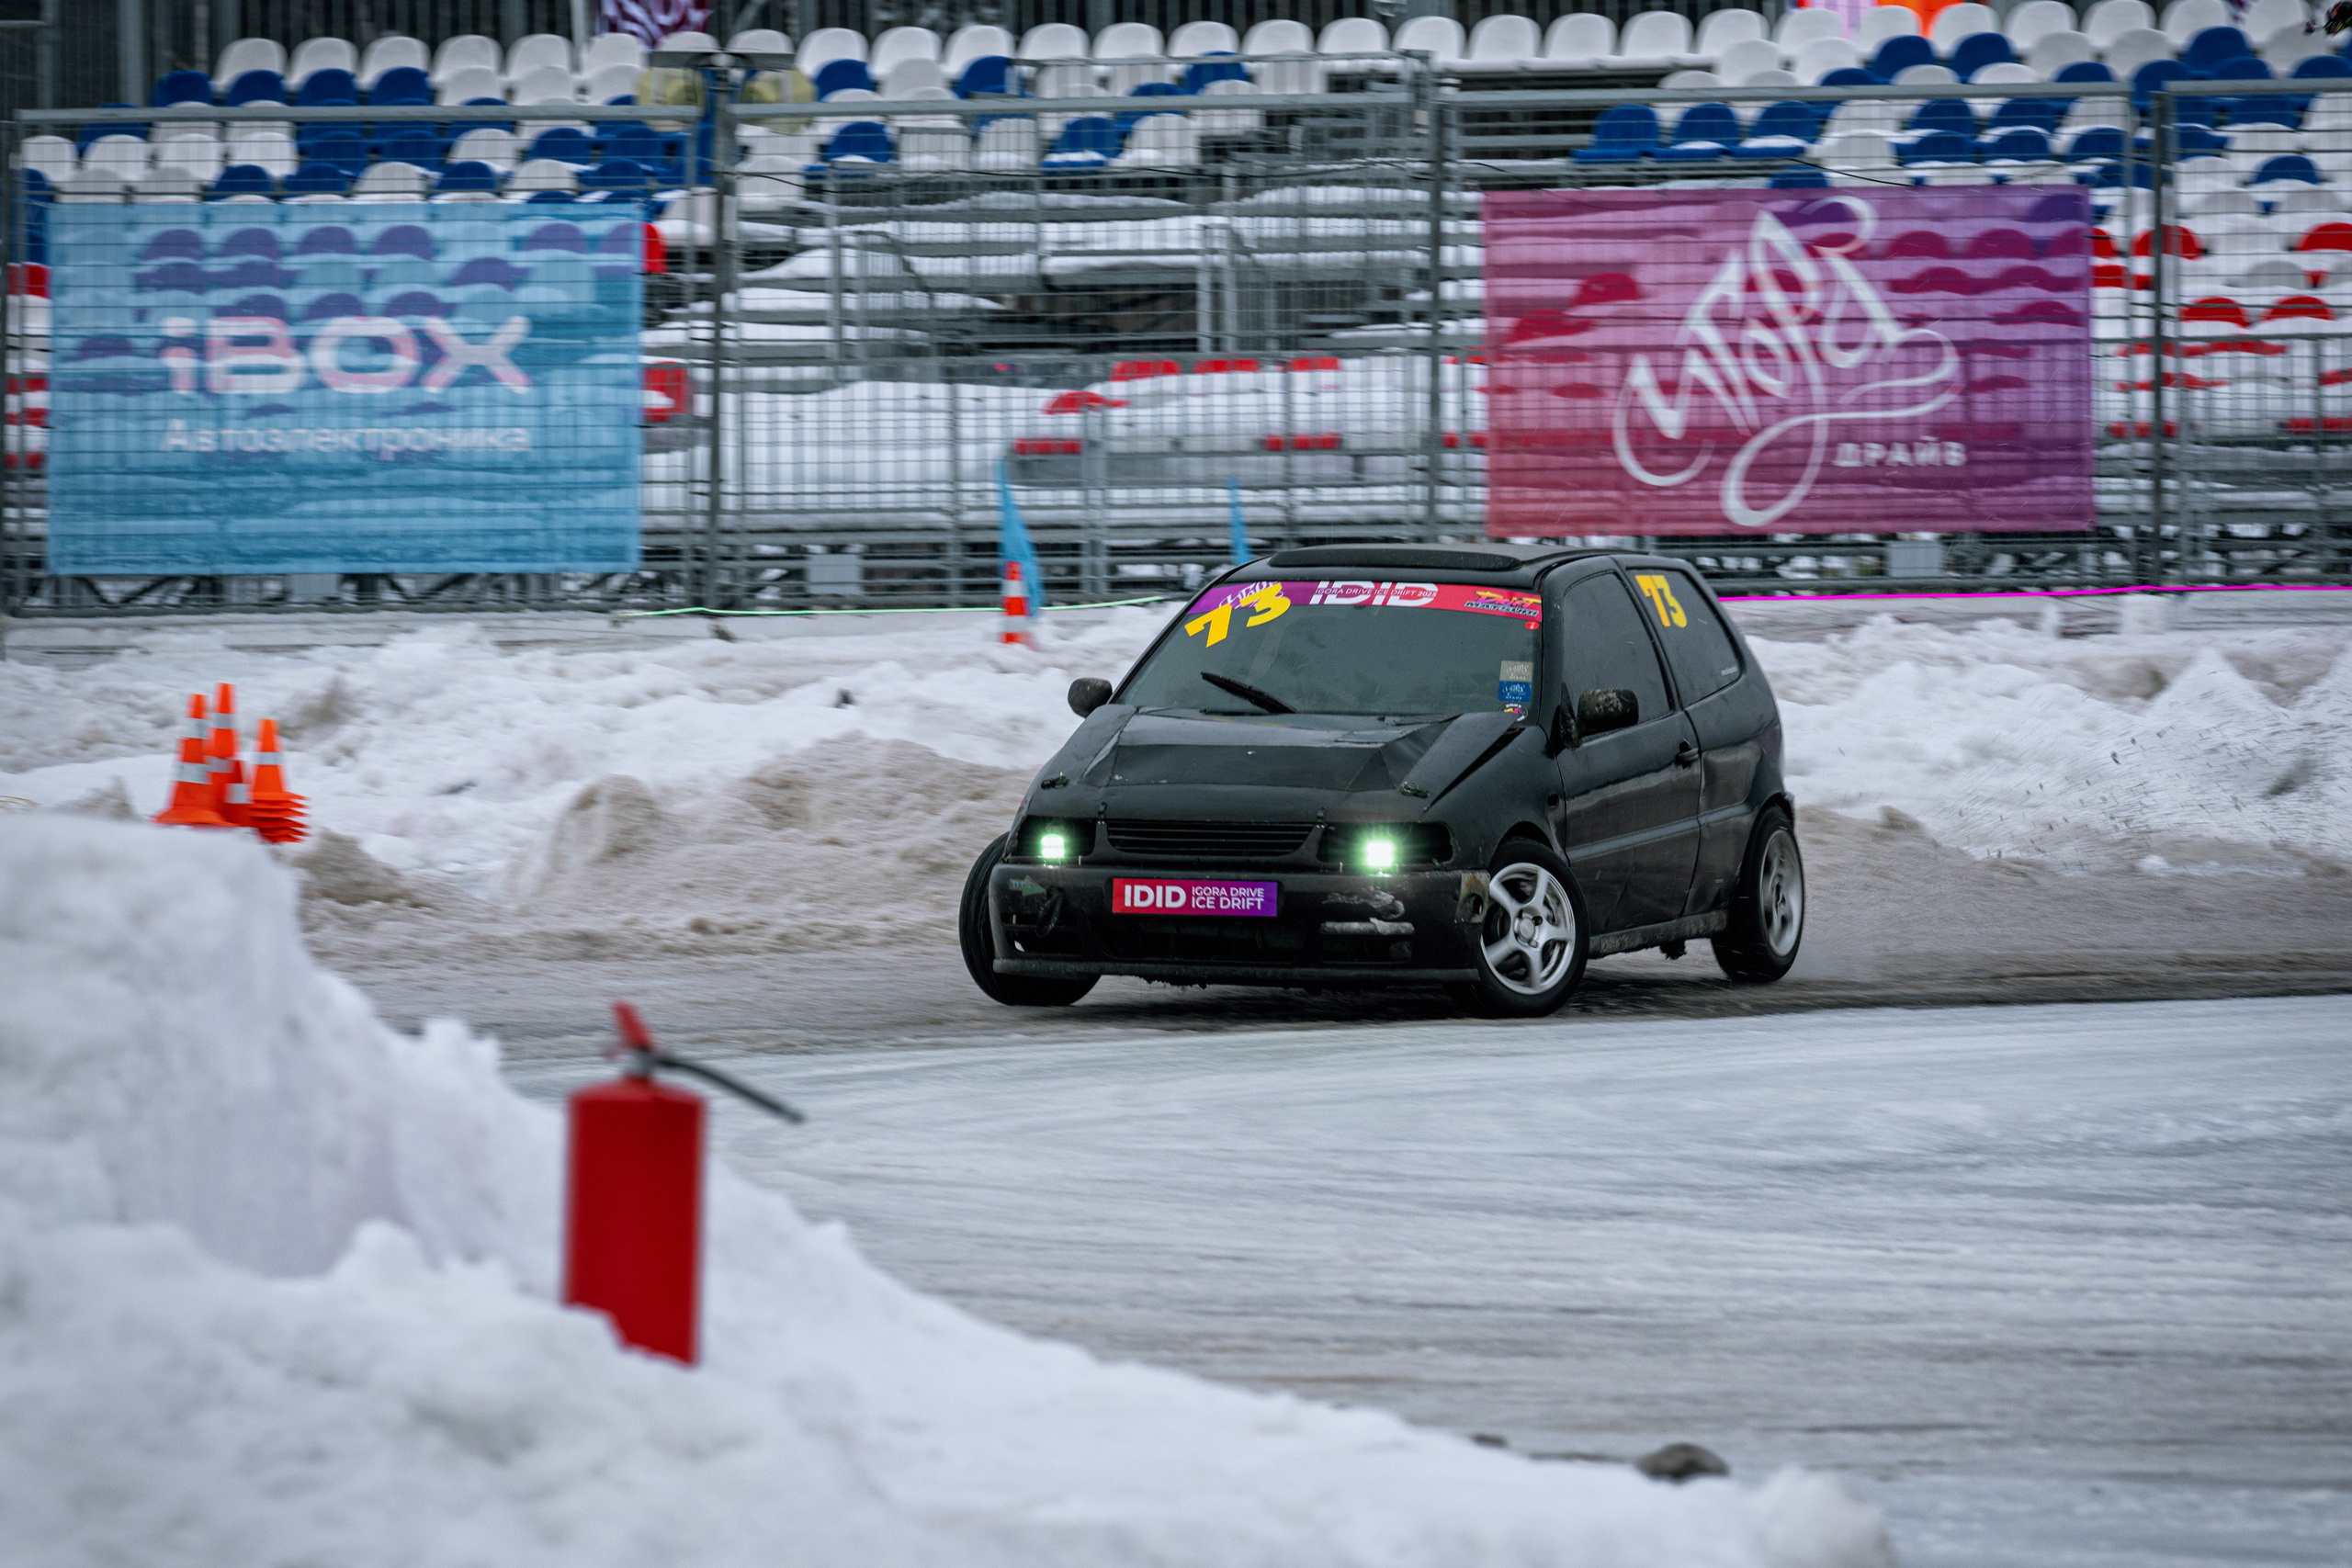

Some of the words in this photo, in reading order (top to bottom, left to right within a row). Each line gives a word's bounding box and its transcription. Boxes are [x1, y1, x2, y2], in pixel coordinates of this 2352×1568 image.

[160, 316, 532, 394] iBOX
[159, 418, 533, 461] Автоэлектроника
[1833, 434, 1967, 467] ДРАЙВ
[1184, 581, 1291, 649] 73
[1635, 574, 1688, 628] 73
[1124, 884, 1186, 908] IDID
[1192, 886, 1227, 897] IGORA
[1229, 886, 1265, 898] DRIVE
[1192, 896, 1216, 909] ICE
[1219, 897, 1265, 910] DRIFT
